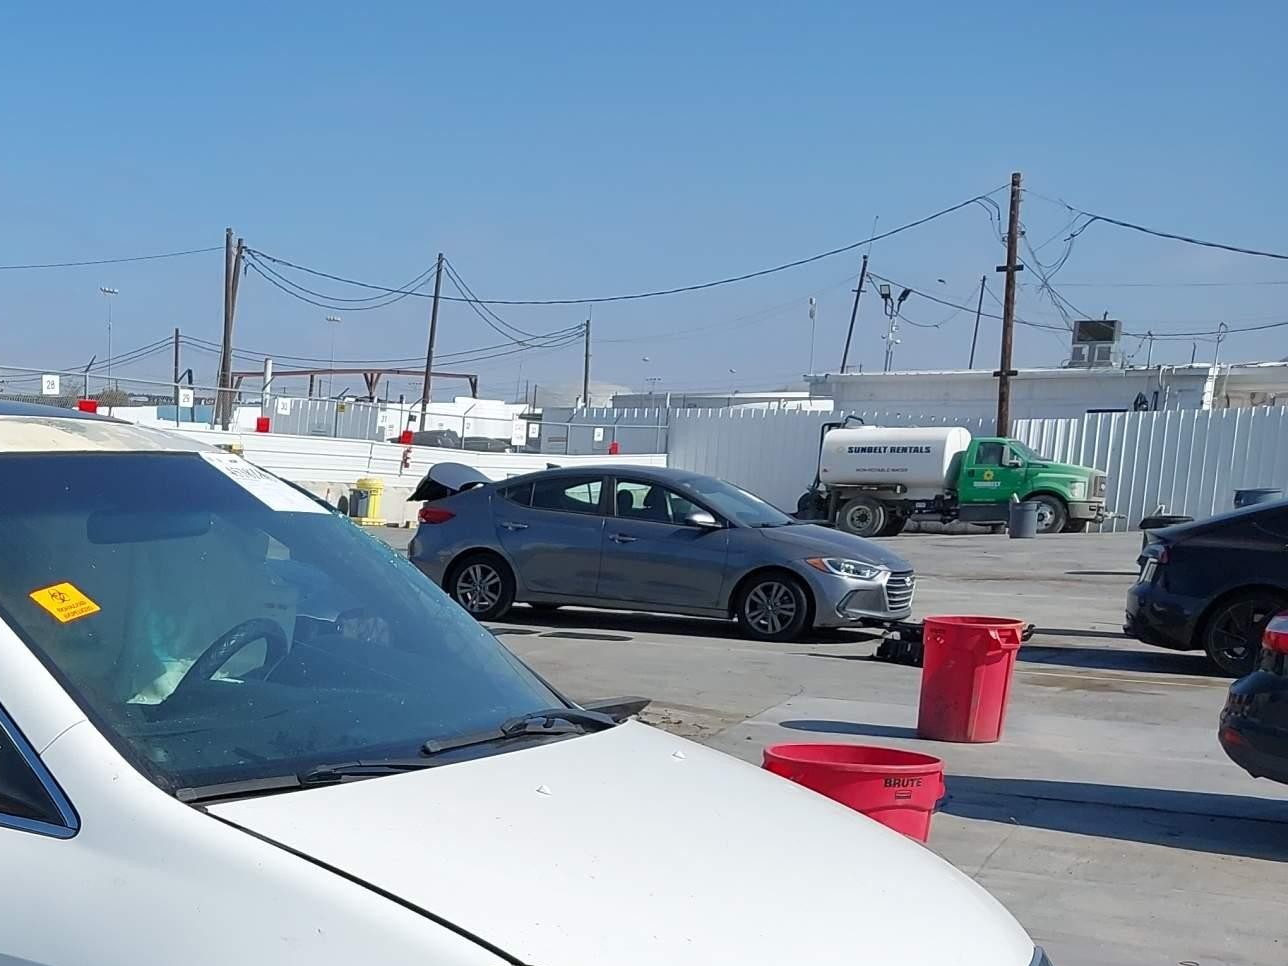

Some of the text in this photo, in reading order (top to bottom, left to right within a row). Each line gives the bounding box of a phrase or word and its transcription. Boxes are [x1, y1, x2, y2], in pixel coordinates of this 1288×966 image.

[46, 380, 56, 391] 28
[847, 446, 932, 454] SUNBELT RENTALS
[883, 776, 923, 788] BRUTE
